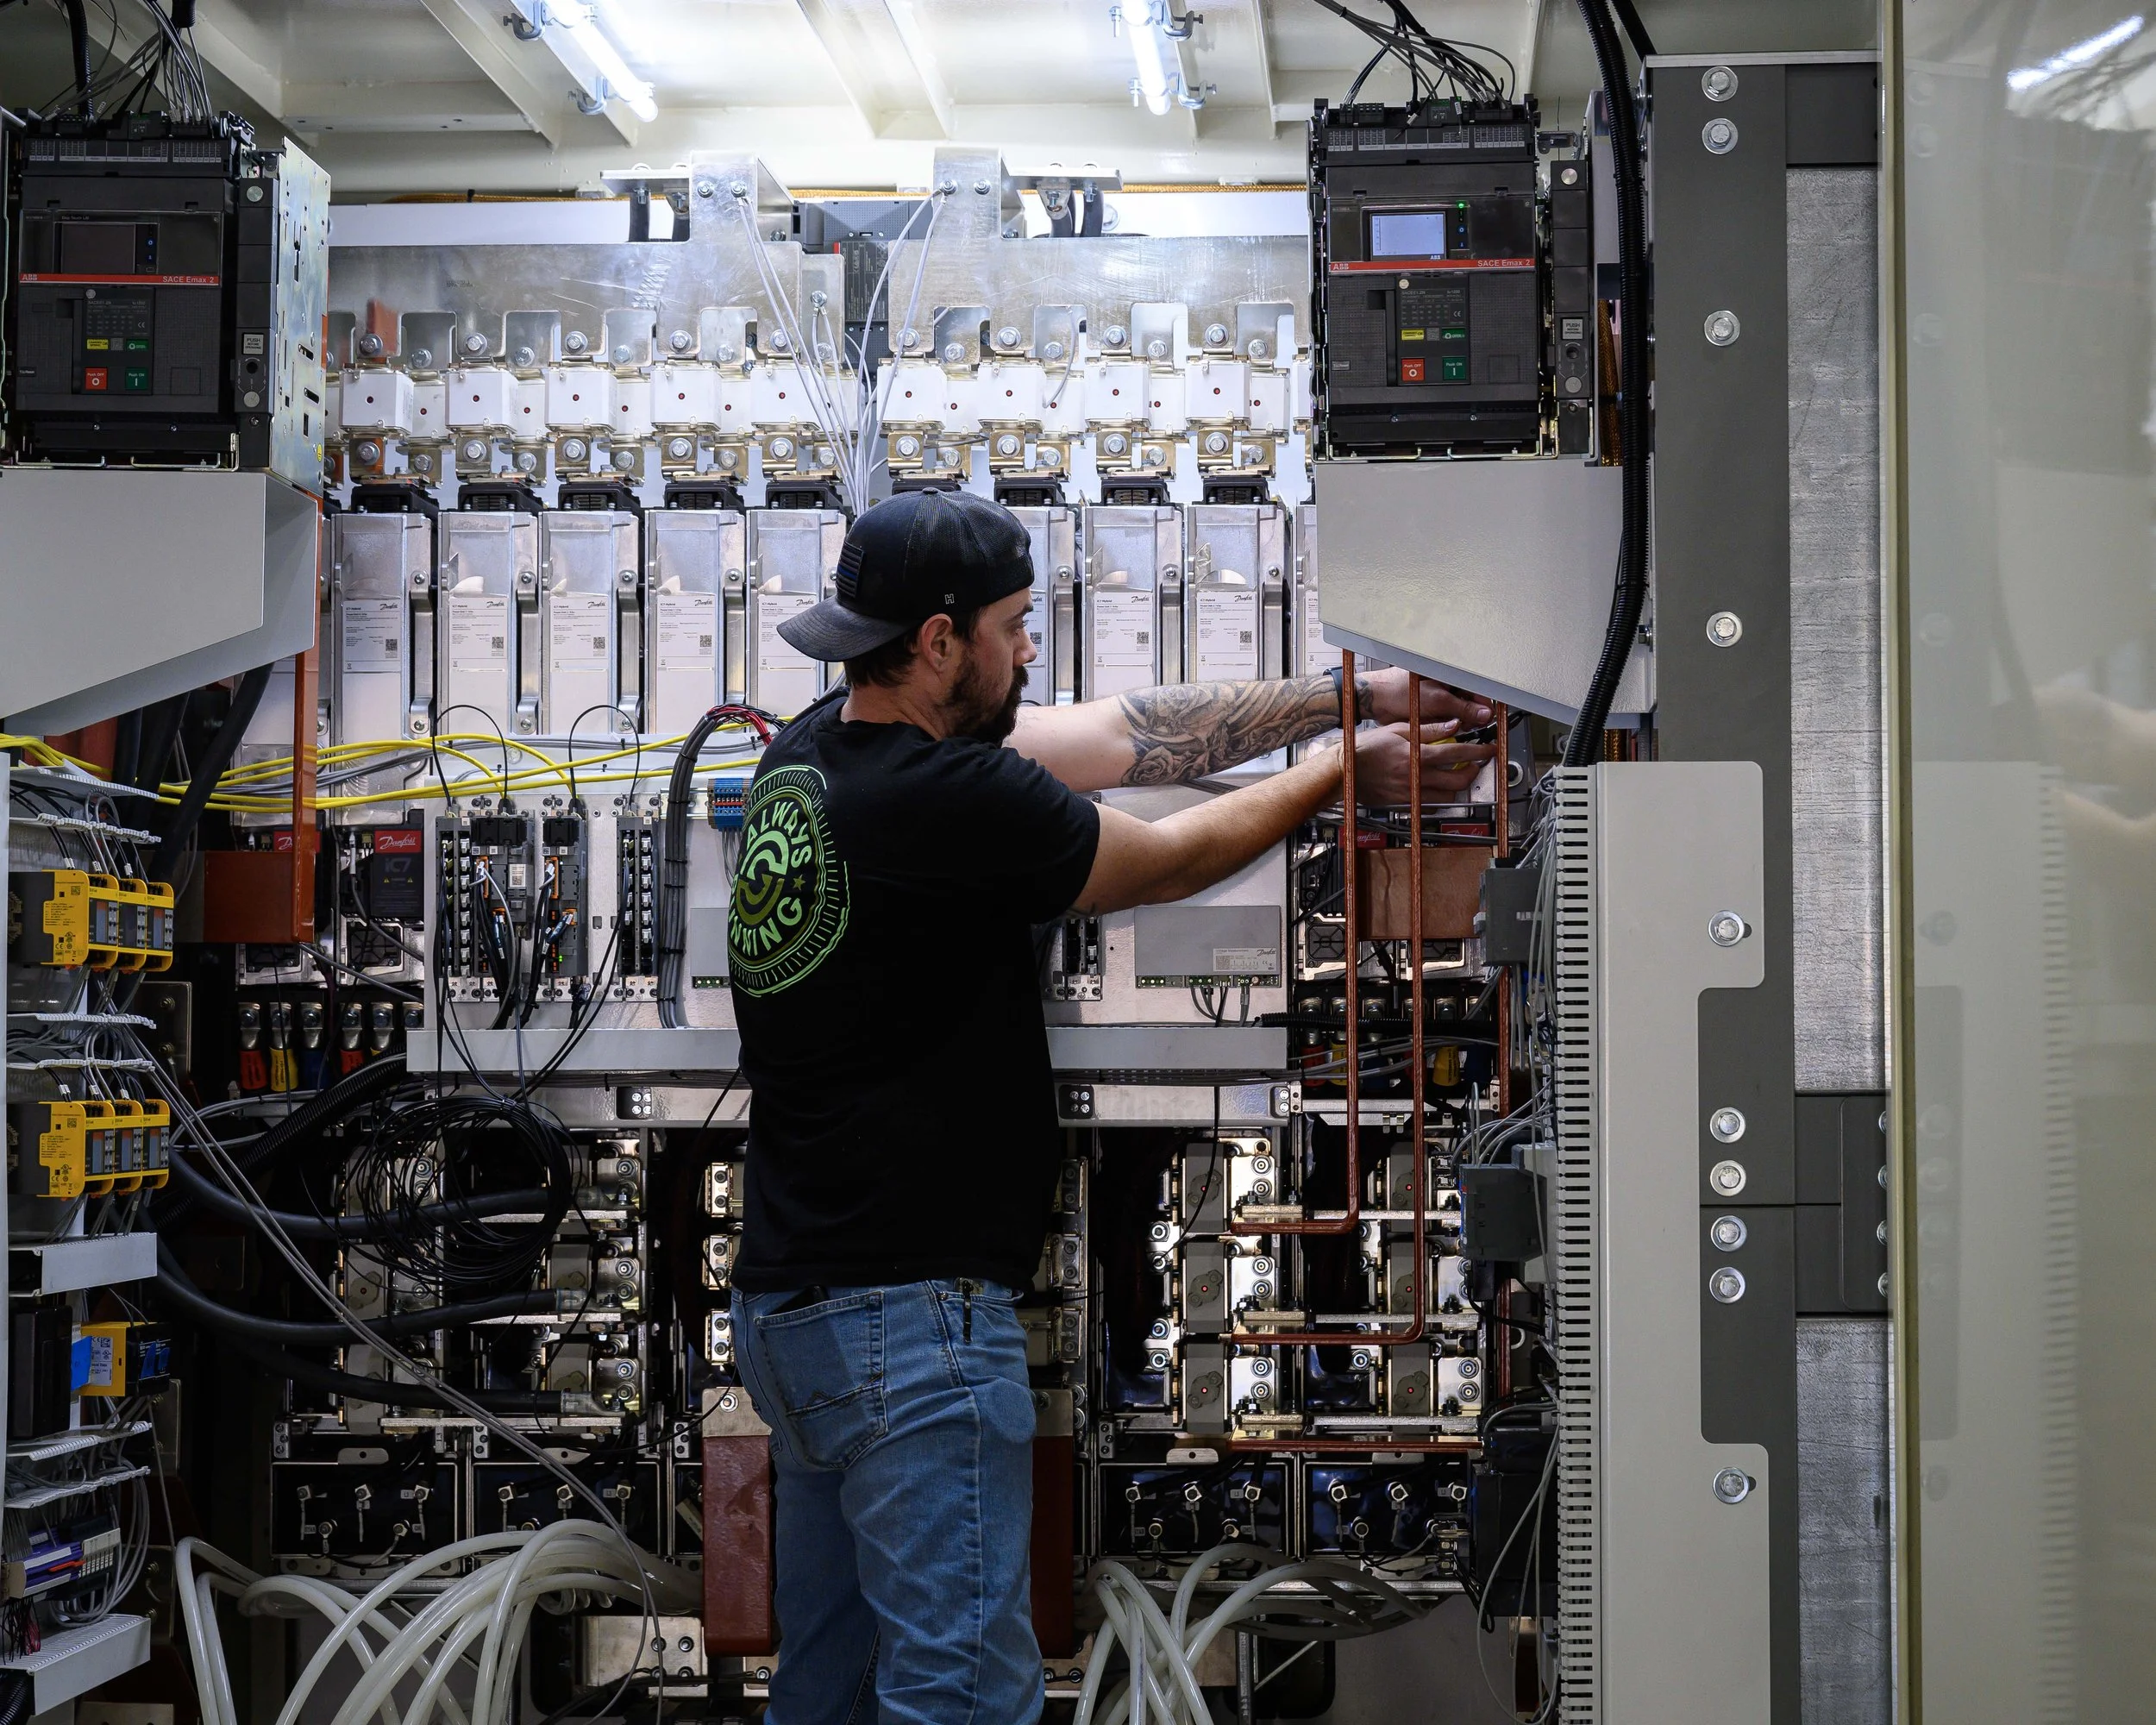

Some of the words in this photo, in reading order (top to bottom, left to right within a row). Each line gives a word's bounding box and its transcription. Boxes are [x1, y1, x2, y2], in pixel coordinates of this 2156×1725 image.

[796, 598, 814, 606] Danfoss
[379, 834, 416, 850] Danfoss
[747, 801, 812, 869] ALWAYS
[1357, 831, 1381, 843] anfoss
[384, 856, 412, 873] iC7
